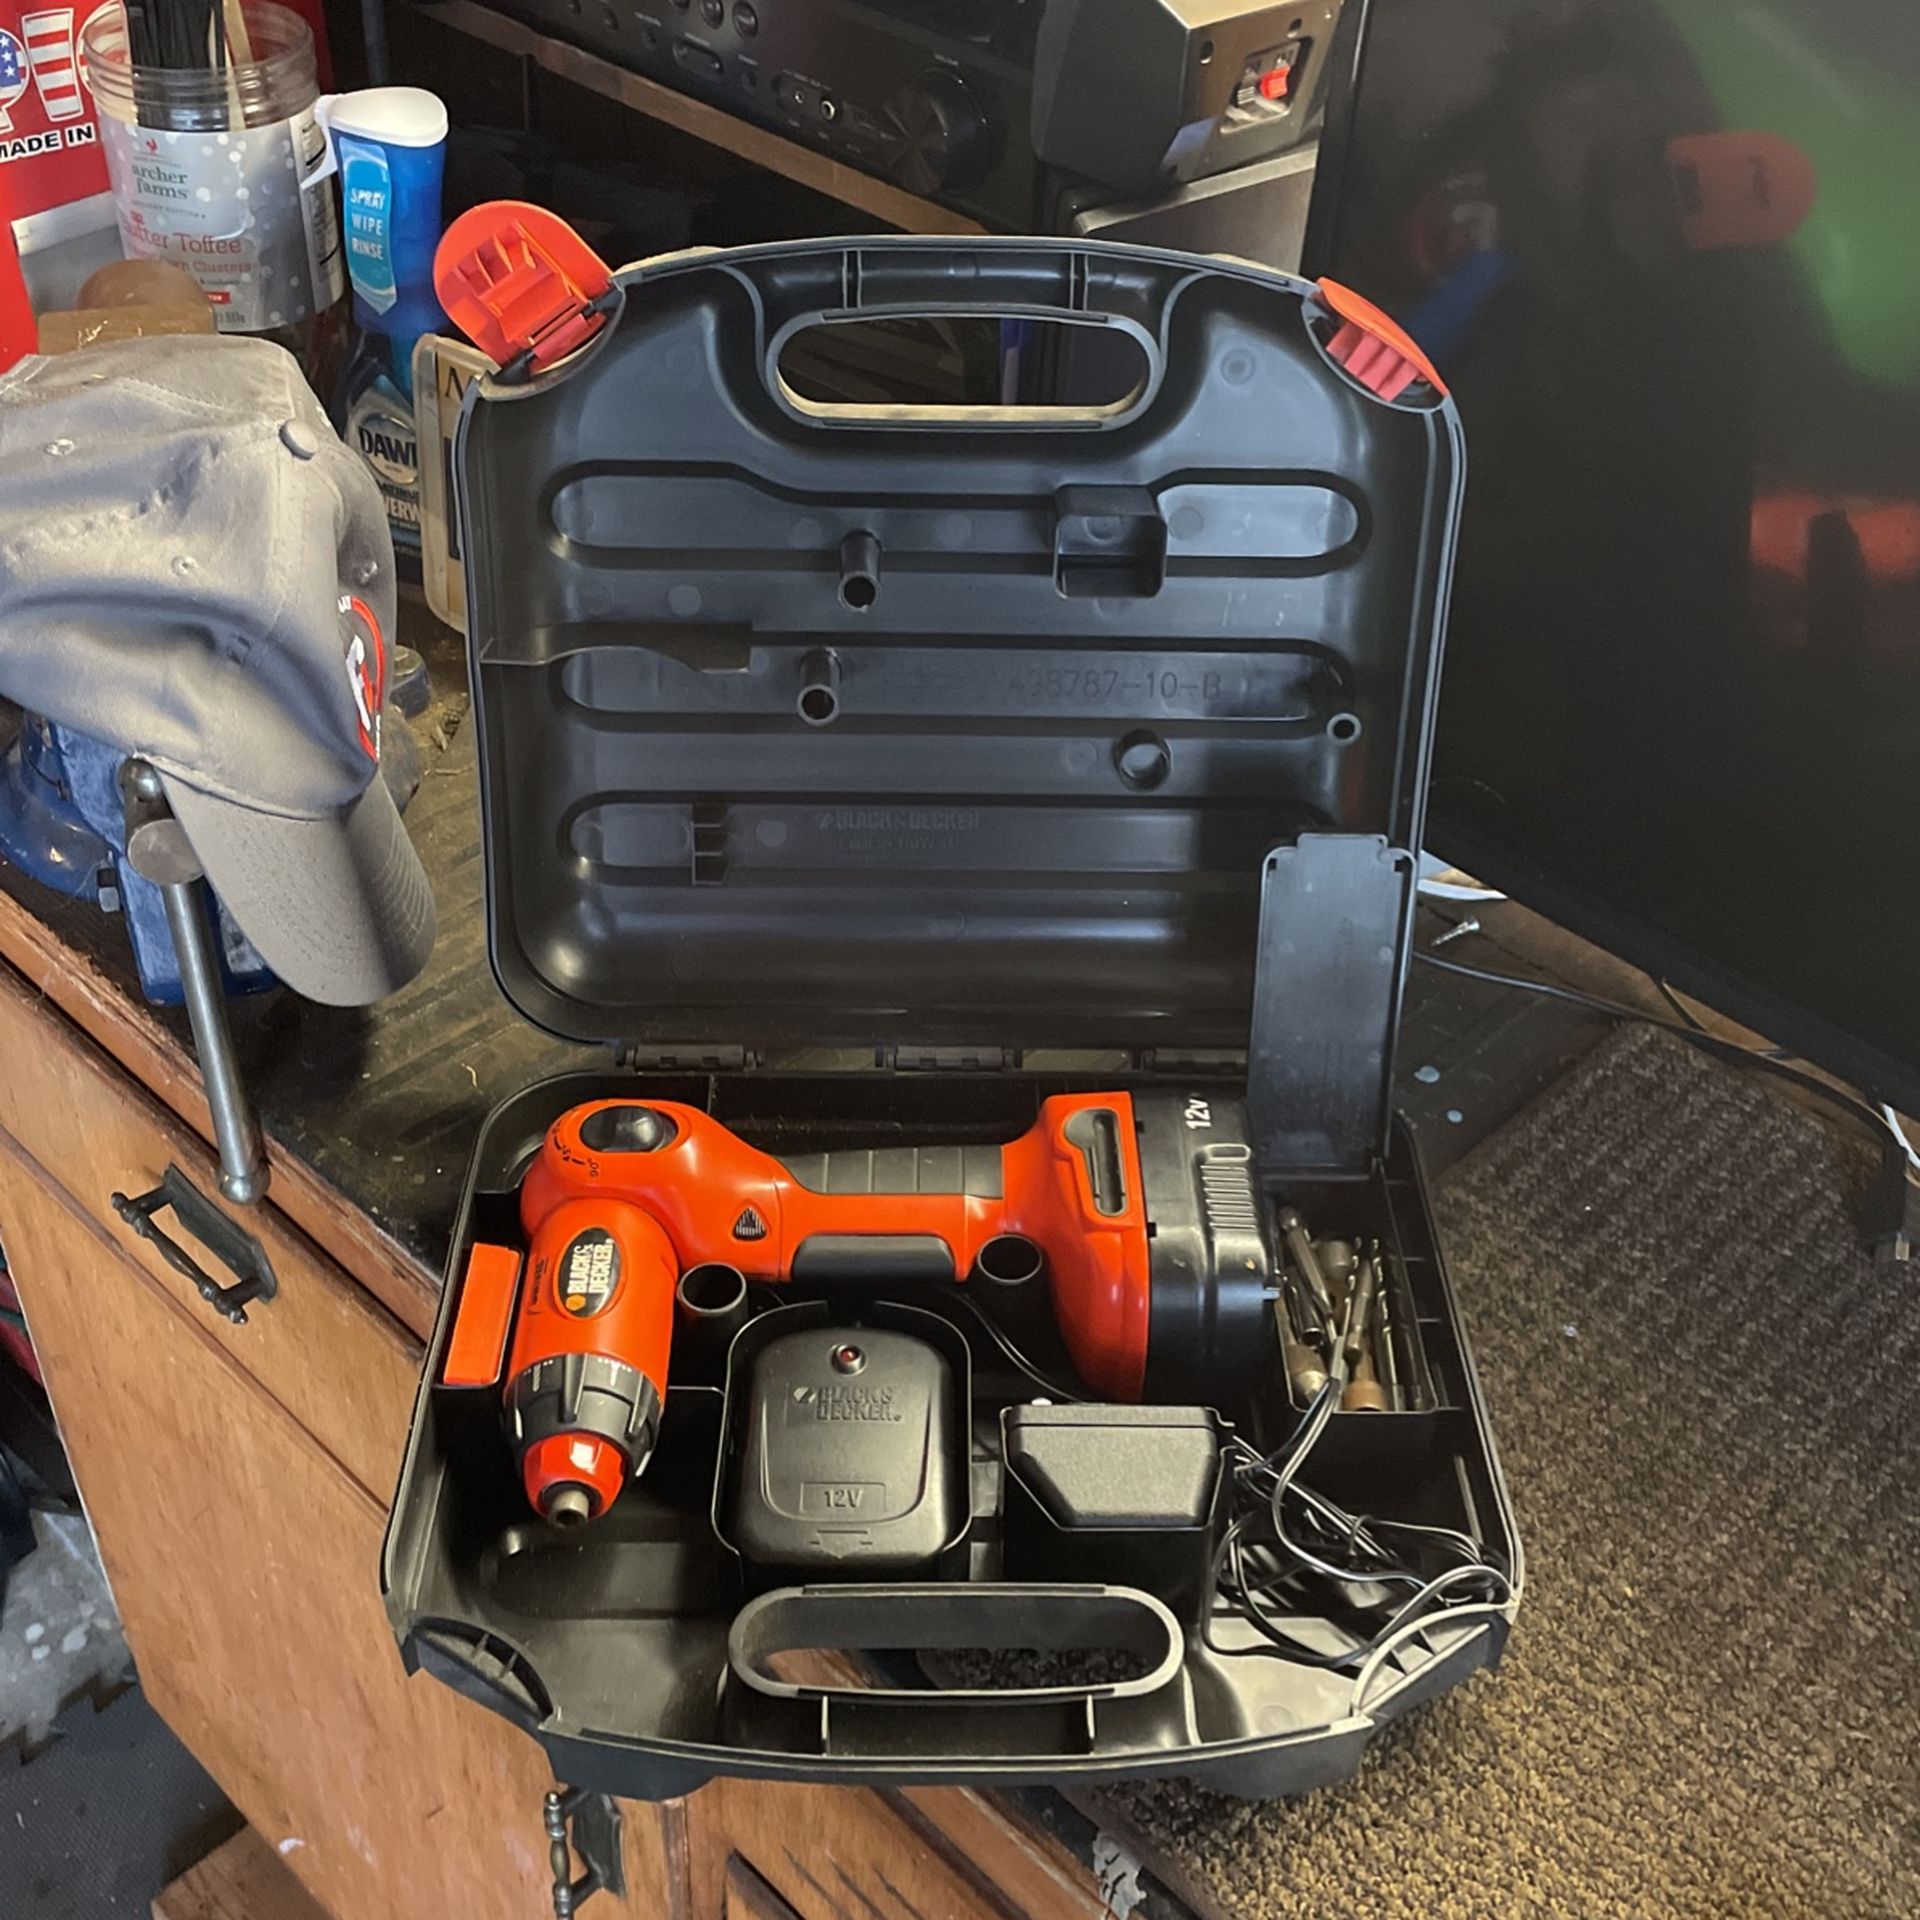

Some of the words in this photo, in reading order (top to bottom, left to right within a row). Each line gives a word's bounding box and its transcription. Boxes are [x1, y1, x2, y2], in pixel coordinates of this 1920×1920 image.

[67, 124, 94, 144] IN
[132, 165, 188, 184] archer
[350, 188, 386, 210] SPRAY
[351, 211, 384, 236] WIPE
[173, 232, 242, 254] Toffee
[351, 237, 384, 260] RINSE
[824, 1489, 864, 1508] 12V
